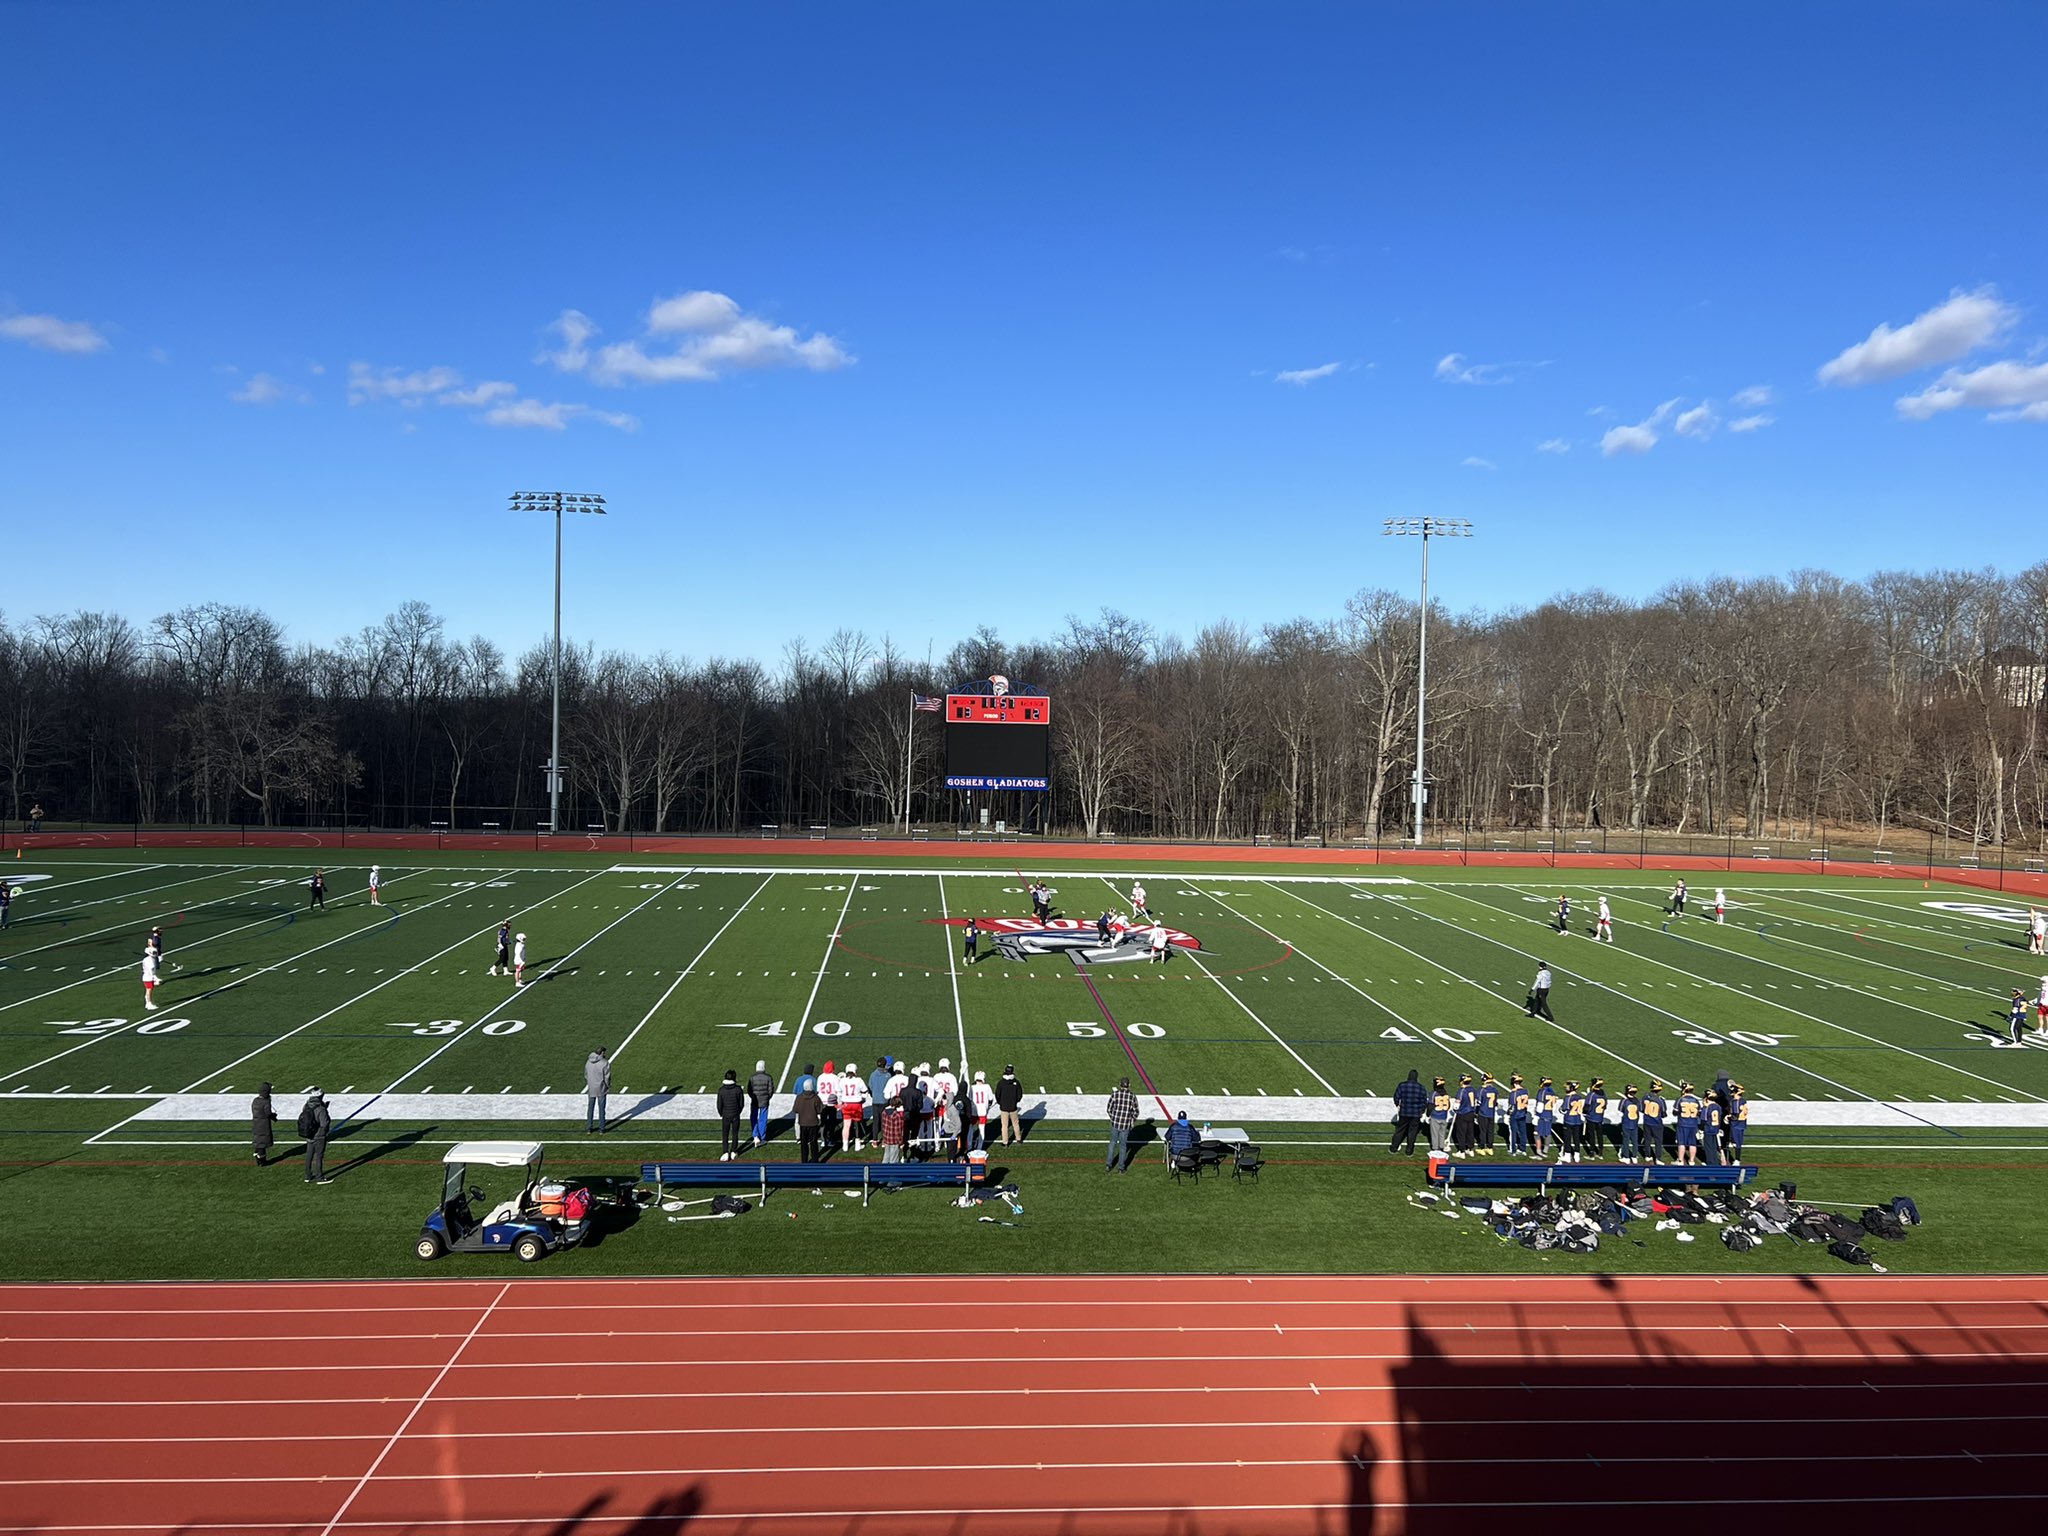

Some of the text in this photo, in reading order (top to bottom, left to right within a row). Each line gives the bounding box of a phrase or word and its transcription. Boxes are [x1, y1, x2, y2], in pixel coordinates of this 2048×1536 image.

[965, 707, 971, 718] 3
[1001, 711, 1006, 721] 3
[1033, 709, 1040, 720] 2
[947, 778, 1046, 788] GOSHEN GLADIATORS
[994, 919, 1195, 941] GOSN
[412, 1019, 527, 1036] 30
[748, 1020, 852, 1036] 40
[1066, 1022, 1166, 1038] 50
[820, 1082, 833, 1095] 23
[845, 1084, 856, 1096] 17
[975, 1091, 985, 1104] 11
[1486, 1093, 1496, 1108] 7
[1516, 1094, 1529, 1110] 12
[1595, 1098, 1606, 1114] 2
[1627, 1104, 1638, 1120] 8
[1644, 1100, 1660, 1118] 10
[1680, 1102, 1699, 1118] 35
[1711, 1110, 1719, 1126] 9
